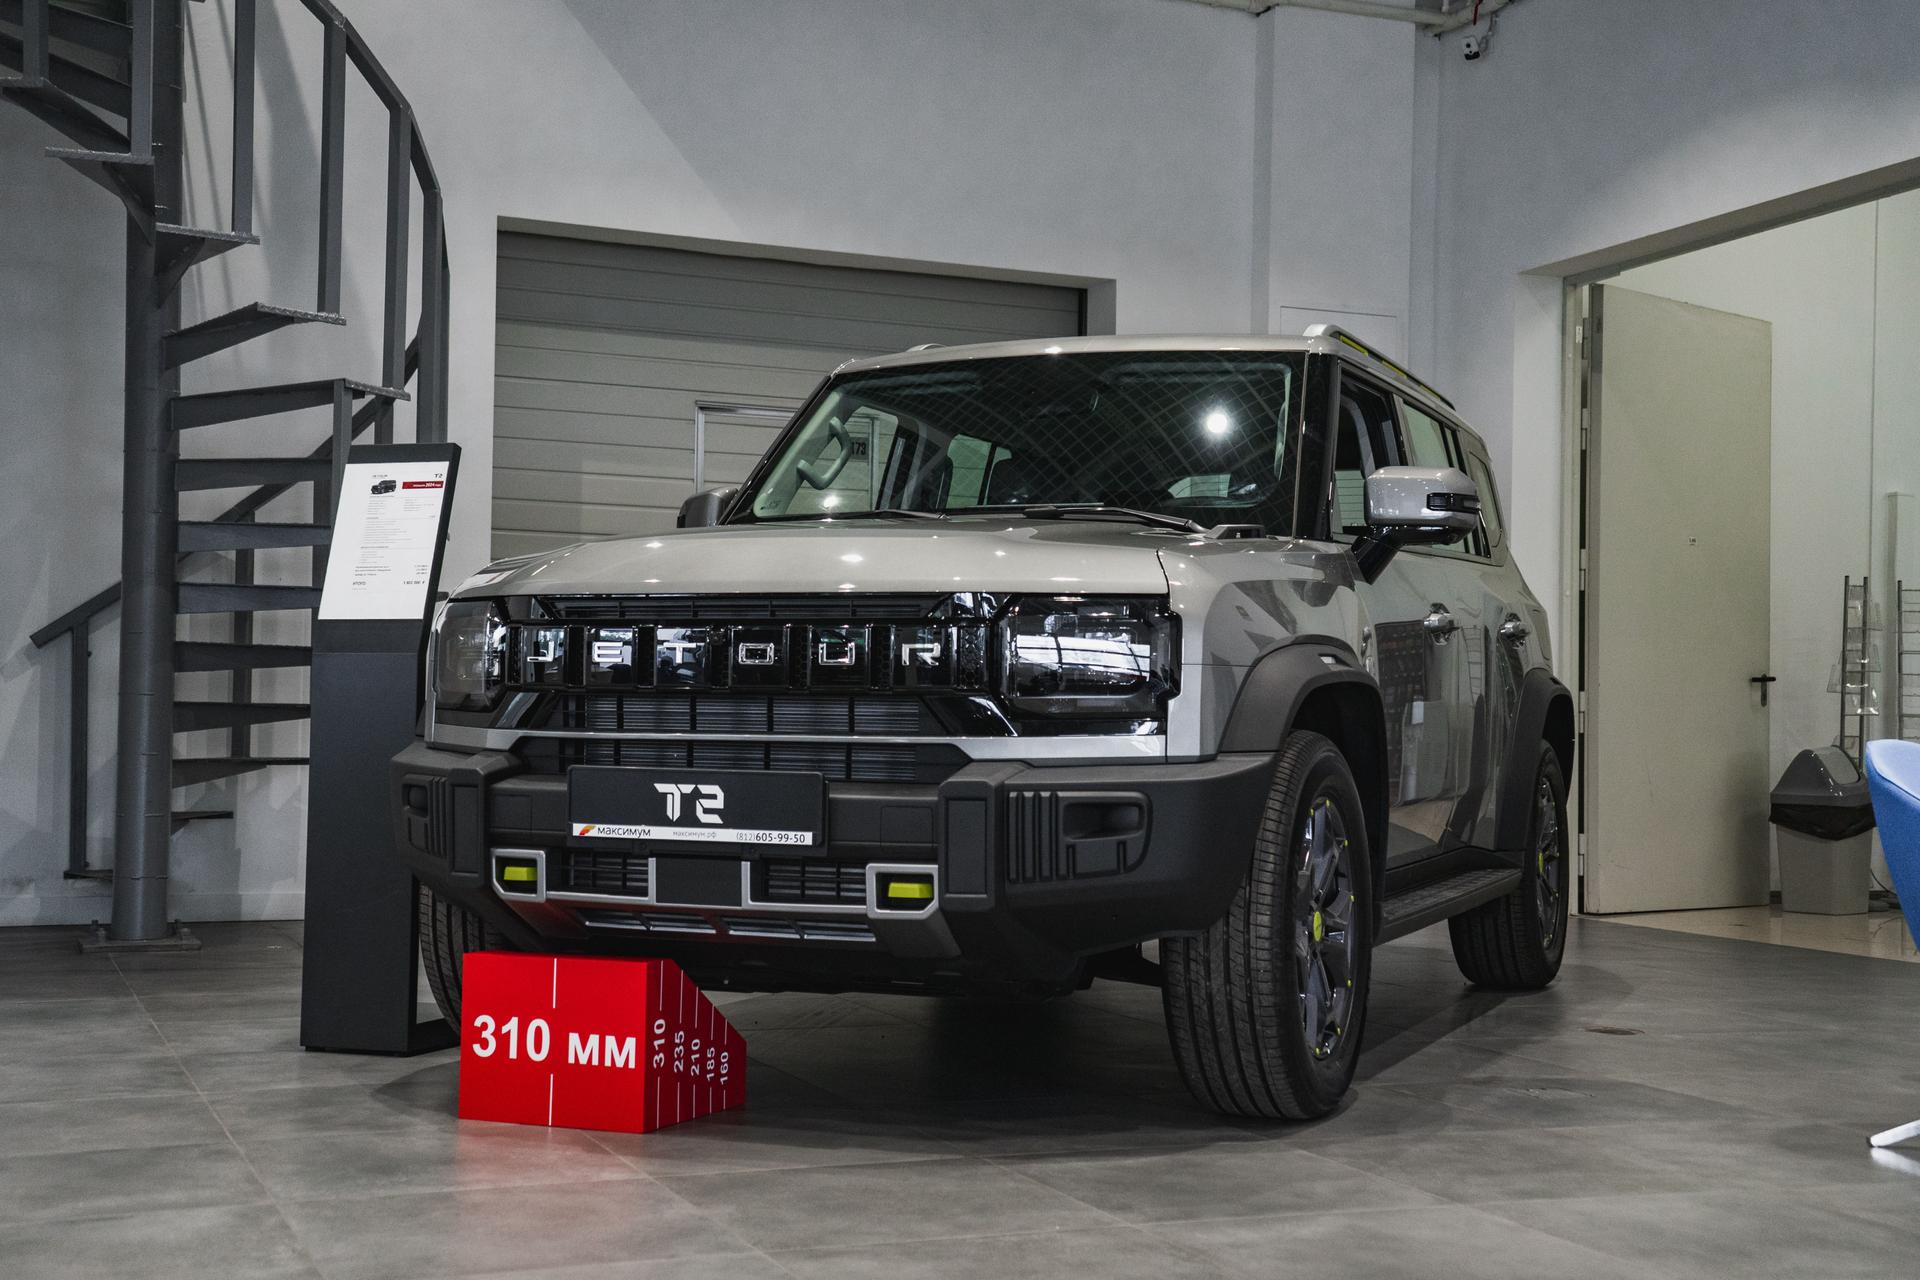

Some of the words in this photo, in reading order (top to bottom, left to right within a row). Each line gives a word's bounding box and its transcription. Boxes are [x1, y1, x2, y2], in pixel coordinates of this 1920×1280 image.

[527, 641, 941, 667] JETOUR
[653, 783, 724, 824] T2
[597, 826, 651, 839] максимум
[672, 830, 717, 839] максимум.рф
[472, 1014, 551, 1062] 310
[653, 1018, 666, 1069] 310
[673, 1030, 685, 1073] 235
[690, 1038, 701, 1077] 210
[706, 1047, 716, 1082] 185
[720, 1051, 729, 1085] 160
